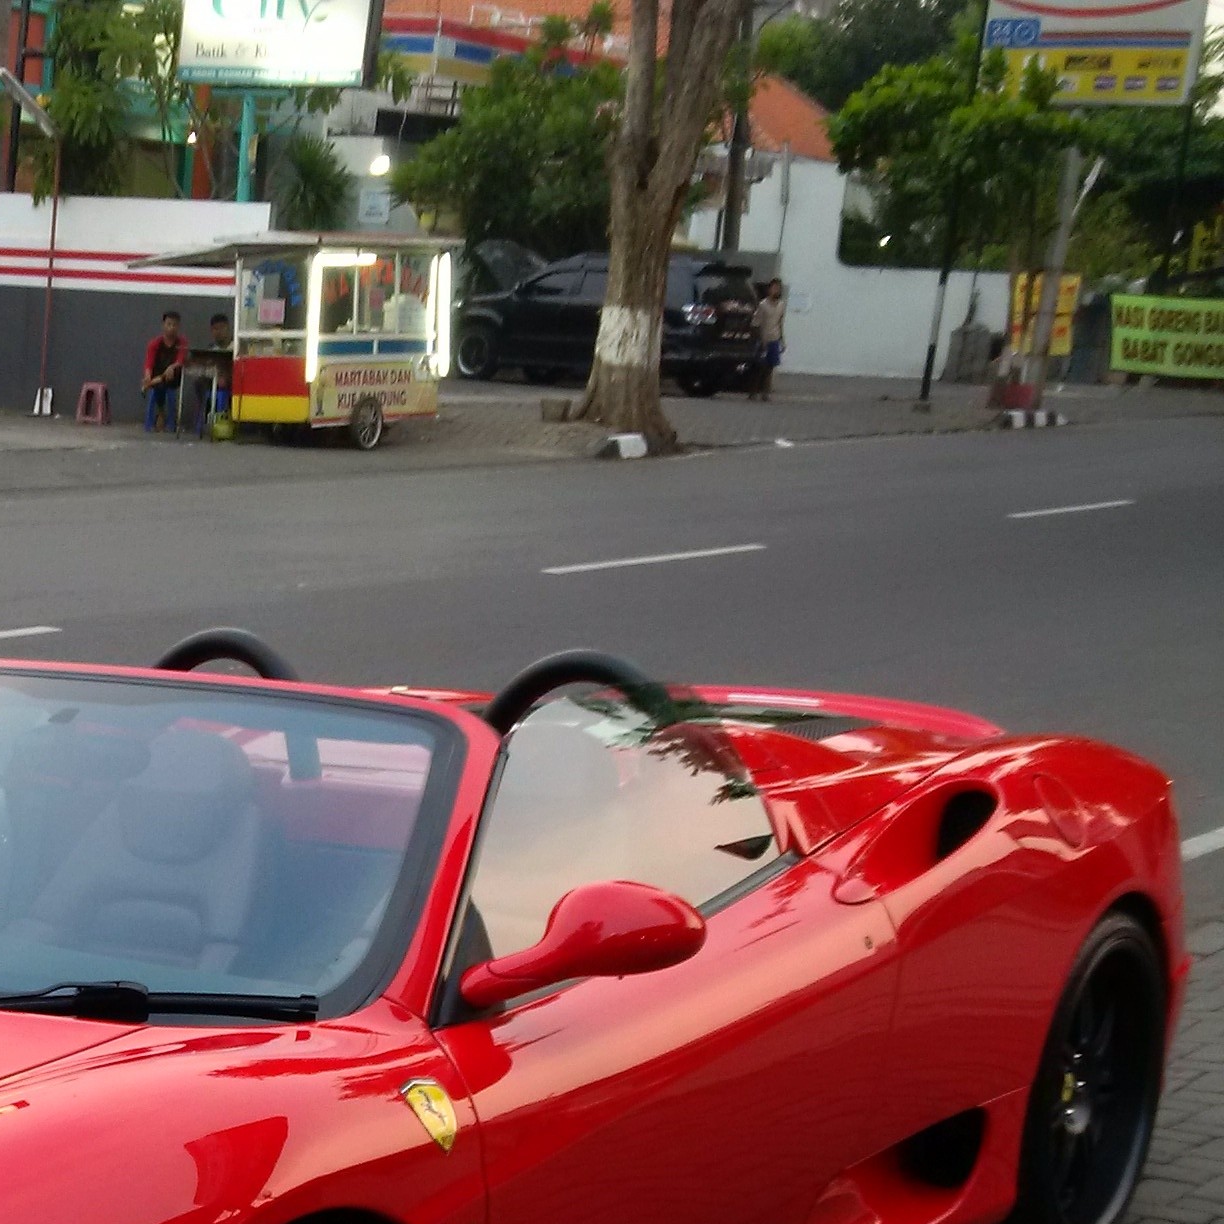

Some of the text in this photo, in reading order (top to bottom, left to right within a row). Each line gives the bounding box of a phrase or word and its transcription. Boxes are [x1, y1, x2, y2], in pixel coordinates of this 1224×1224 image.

[196, 42, 226, 58] Batik
[1149, 306, 1201, 335] GORENG
[1122, 337, 1167, 363] BABAT
[335, 368, 411, 386] MARTABAK DAN
[337, 391, 357, 410] KUE
